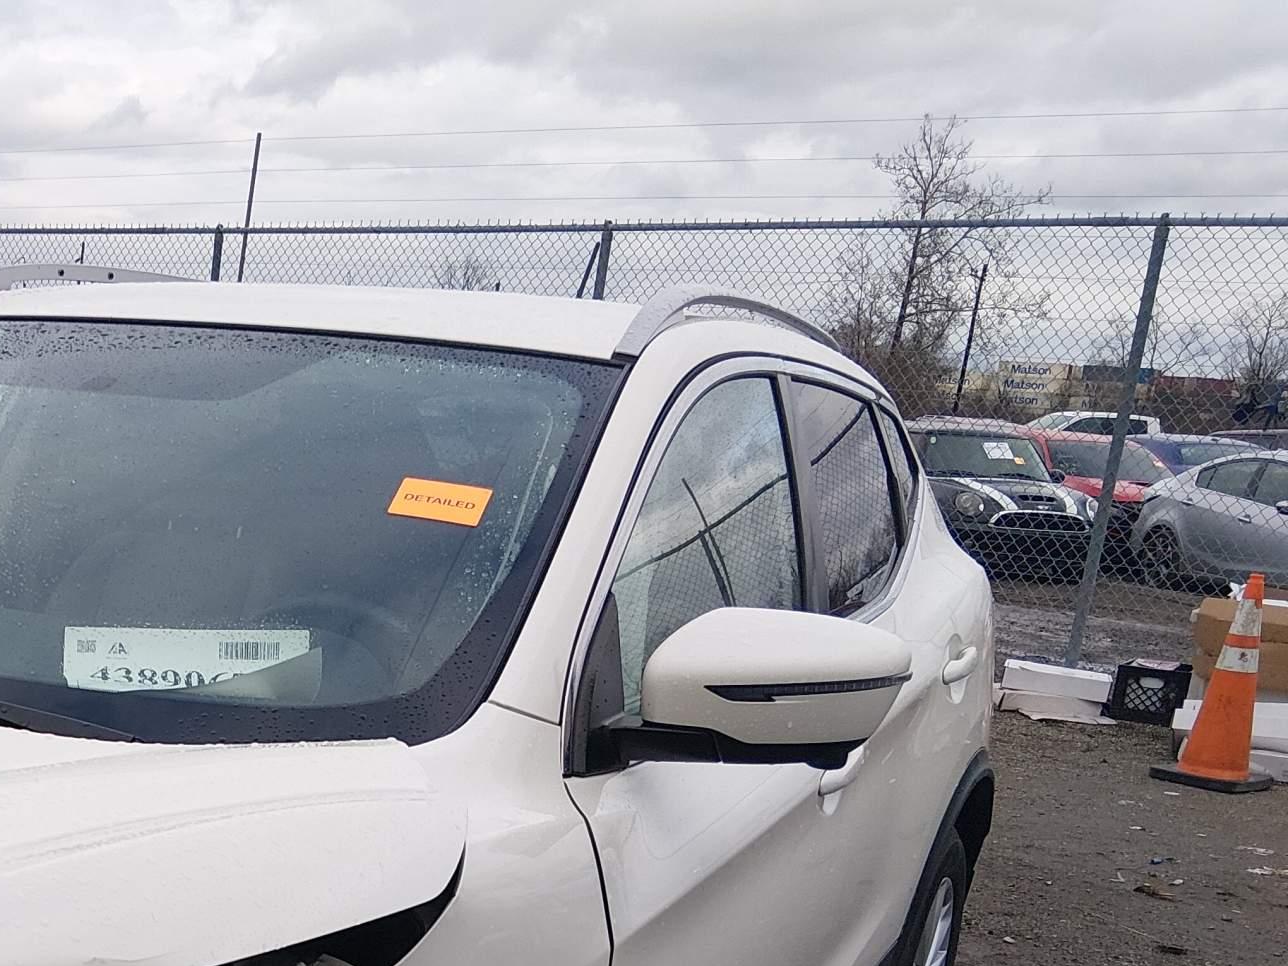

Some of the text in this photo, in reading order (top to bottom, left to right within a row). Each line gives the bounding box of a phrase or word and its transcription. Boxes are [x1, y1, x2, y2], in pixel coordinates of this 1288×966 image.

[1011, 364, 1051, 375] Matson
[935, 375, 970, 386] Matsn
[1004, 379, 1045, 390] Matson
[404, 493, 476, 510] DETAILED
[90, 666, 242, 689] 43890
